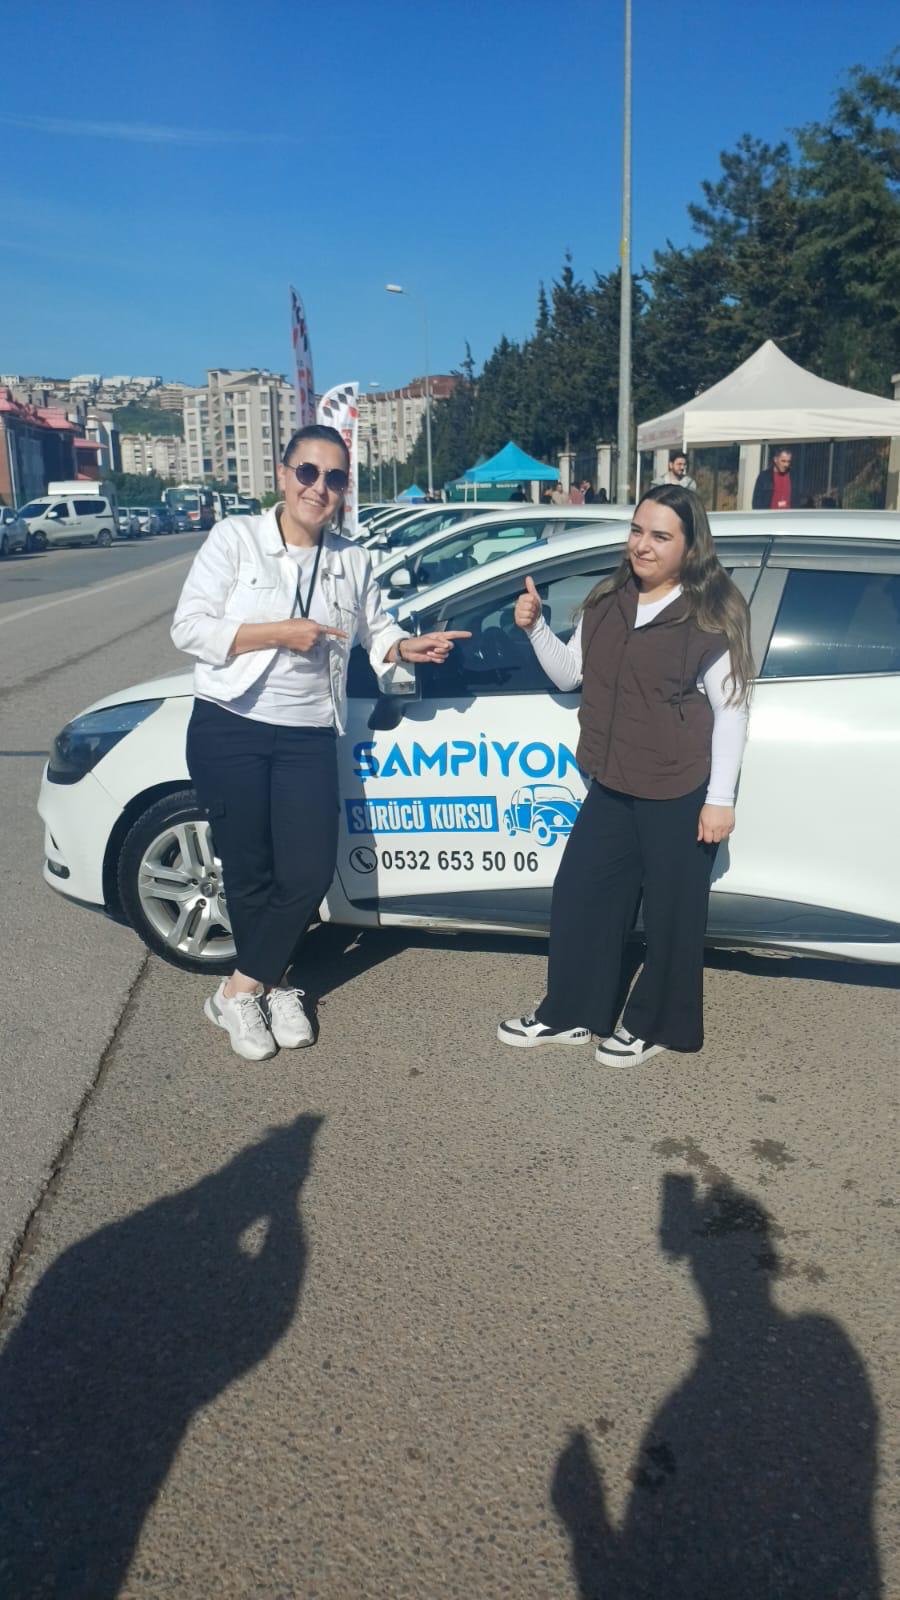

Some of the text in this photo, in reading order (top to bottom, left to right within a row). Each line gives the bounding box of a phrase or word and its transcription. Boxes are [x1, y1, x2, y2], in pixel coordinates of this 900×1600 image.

[352, 802, 493, 831] SÜRÜCÜ KURSU
[381, 850, 539, 872] 0532 653 50 06
